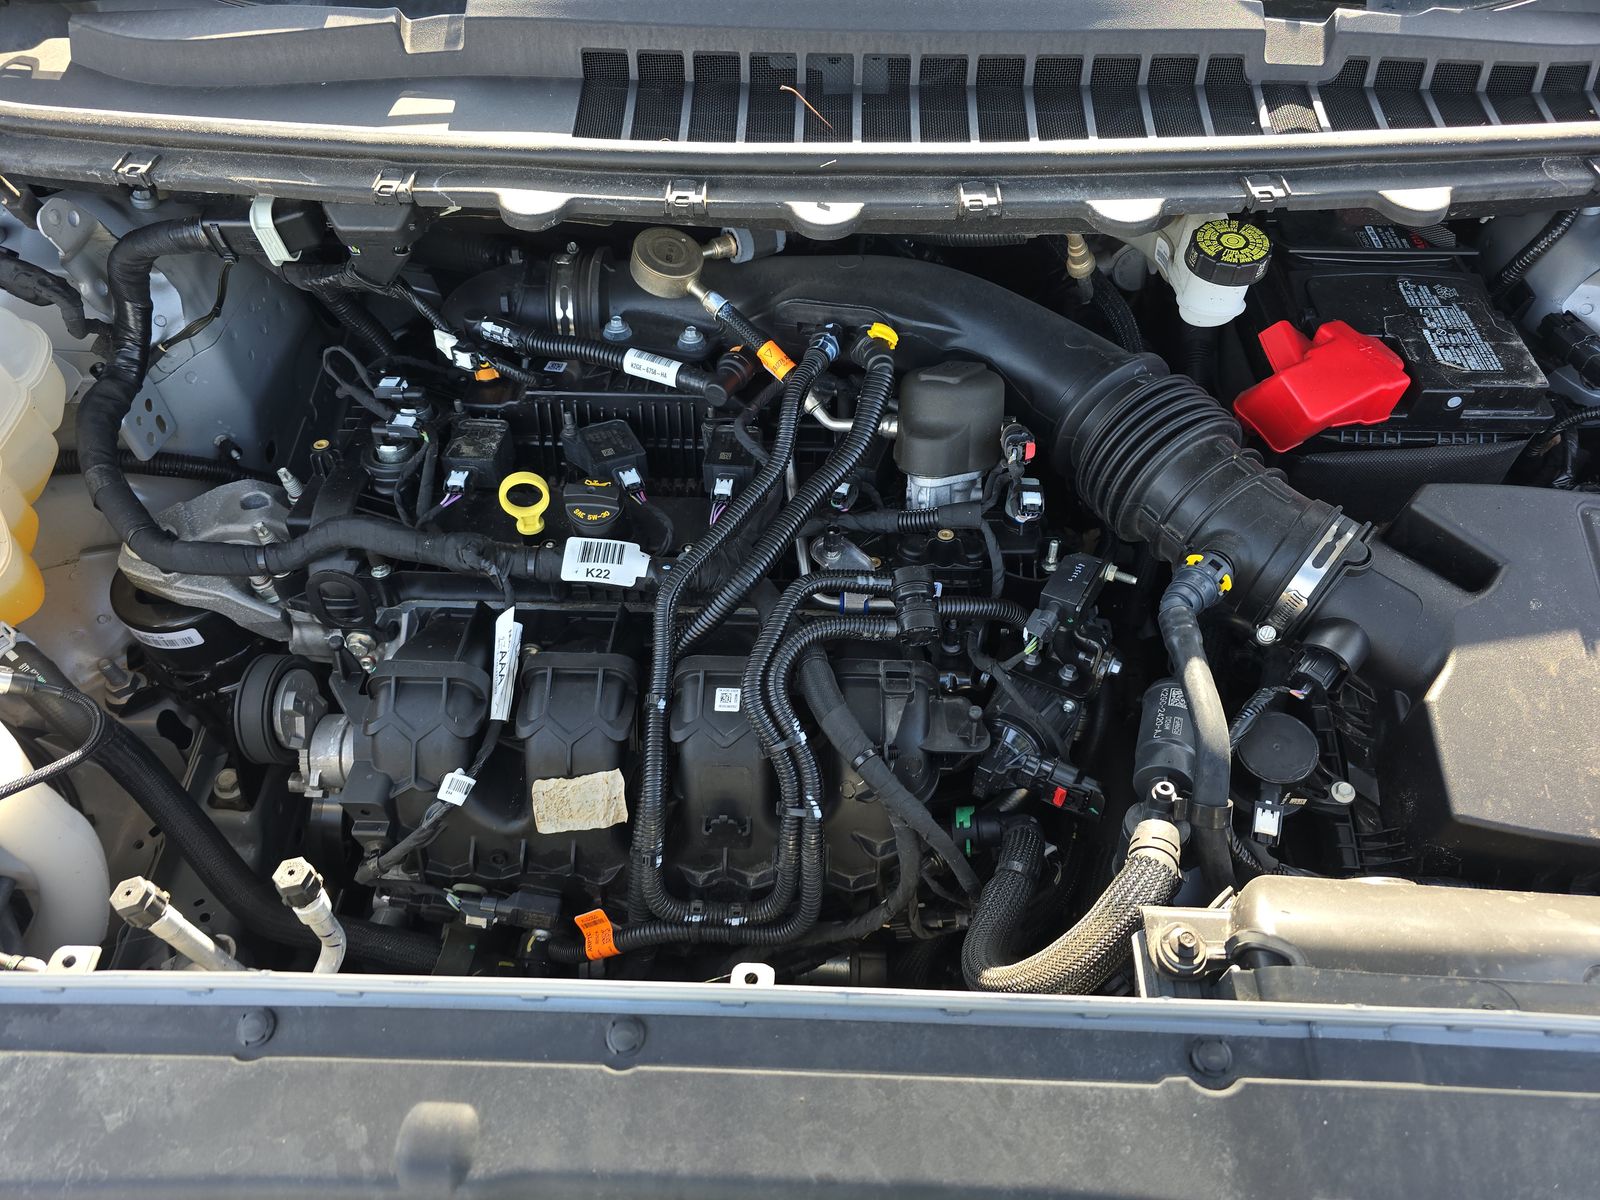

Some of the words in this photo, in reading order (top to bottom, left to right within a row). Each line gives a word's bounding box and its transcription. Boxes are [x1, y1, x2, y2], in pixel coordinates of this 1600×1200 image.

[573, 508, 586, 519] SAE
[587, 510, 610, 521] 5W-30
[585, 567, 611, 580] K22
